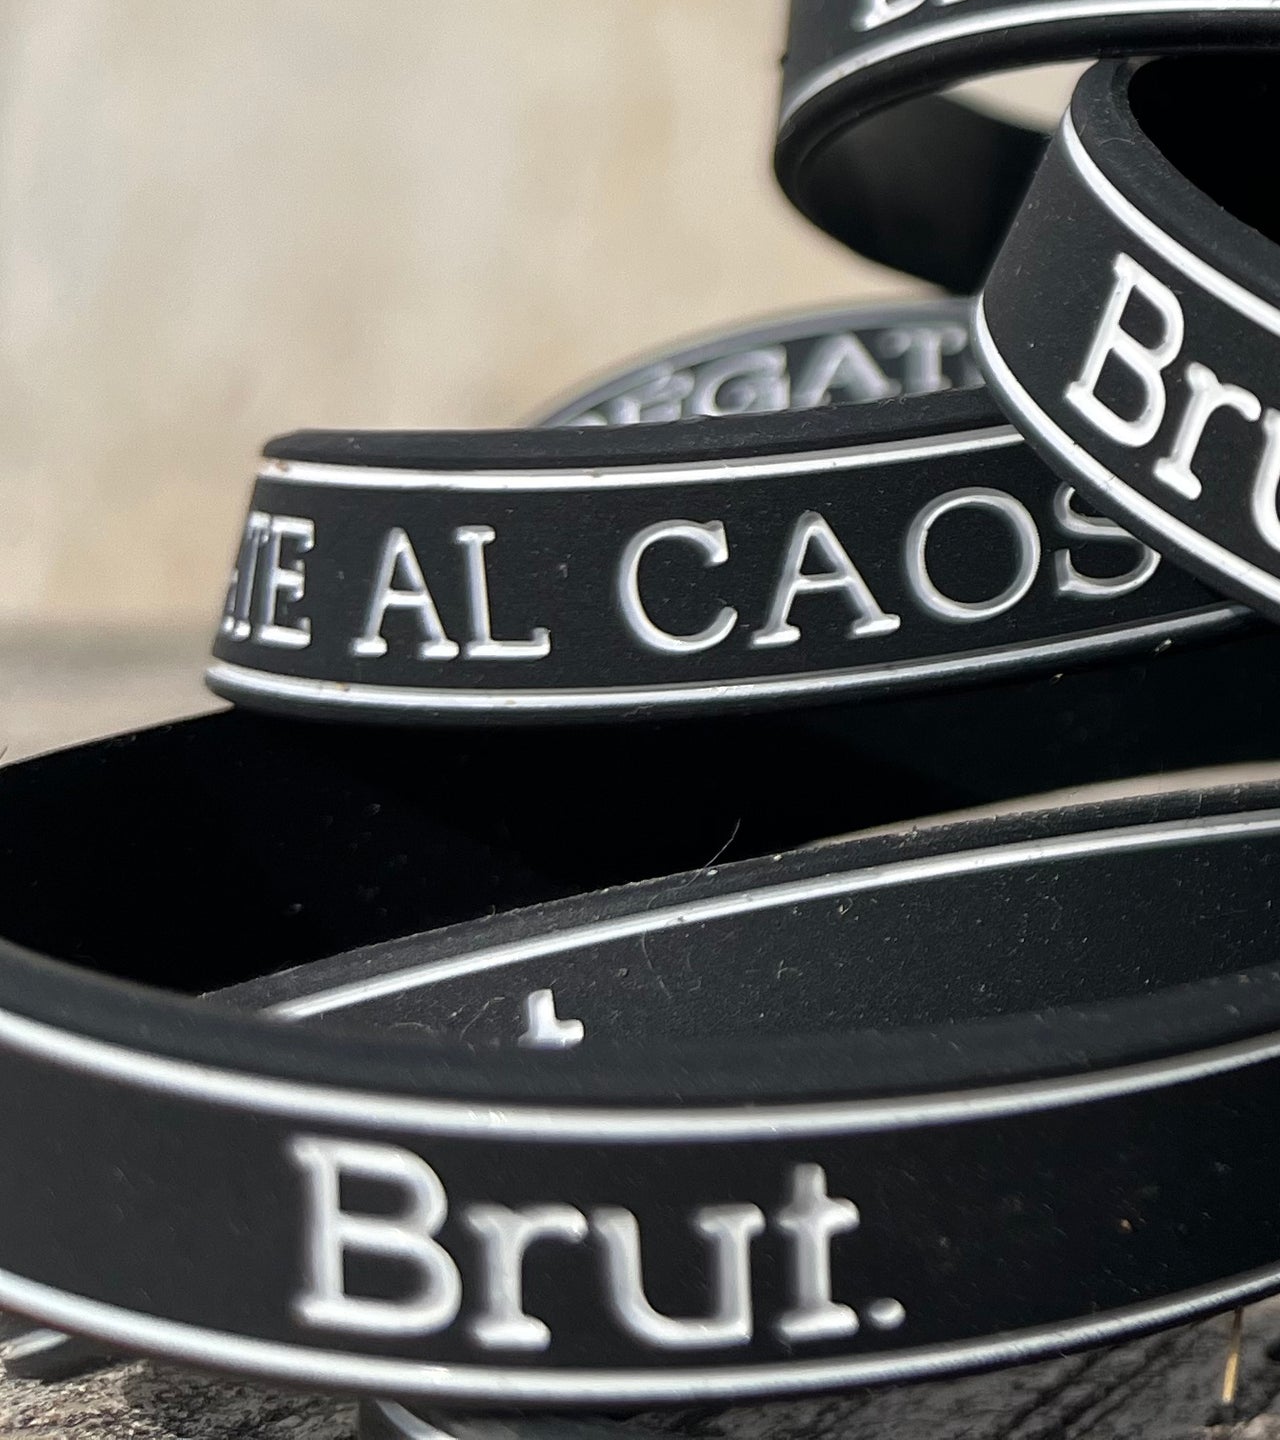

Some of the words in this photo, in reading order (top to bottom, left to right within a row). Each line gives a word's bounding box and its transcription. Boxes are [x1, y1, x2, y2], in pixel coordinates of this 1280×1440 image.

[221, 510, 316, 650] TE
[351, 525, 551, 662] AL
[617, 485, 1163, 654] CAOS
[286, 1132, 908, 1352] Brut.
